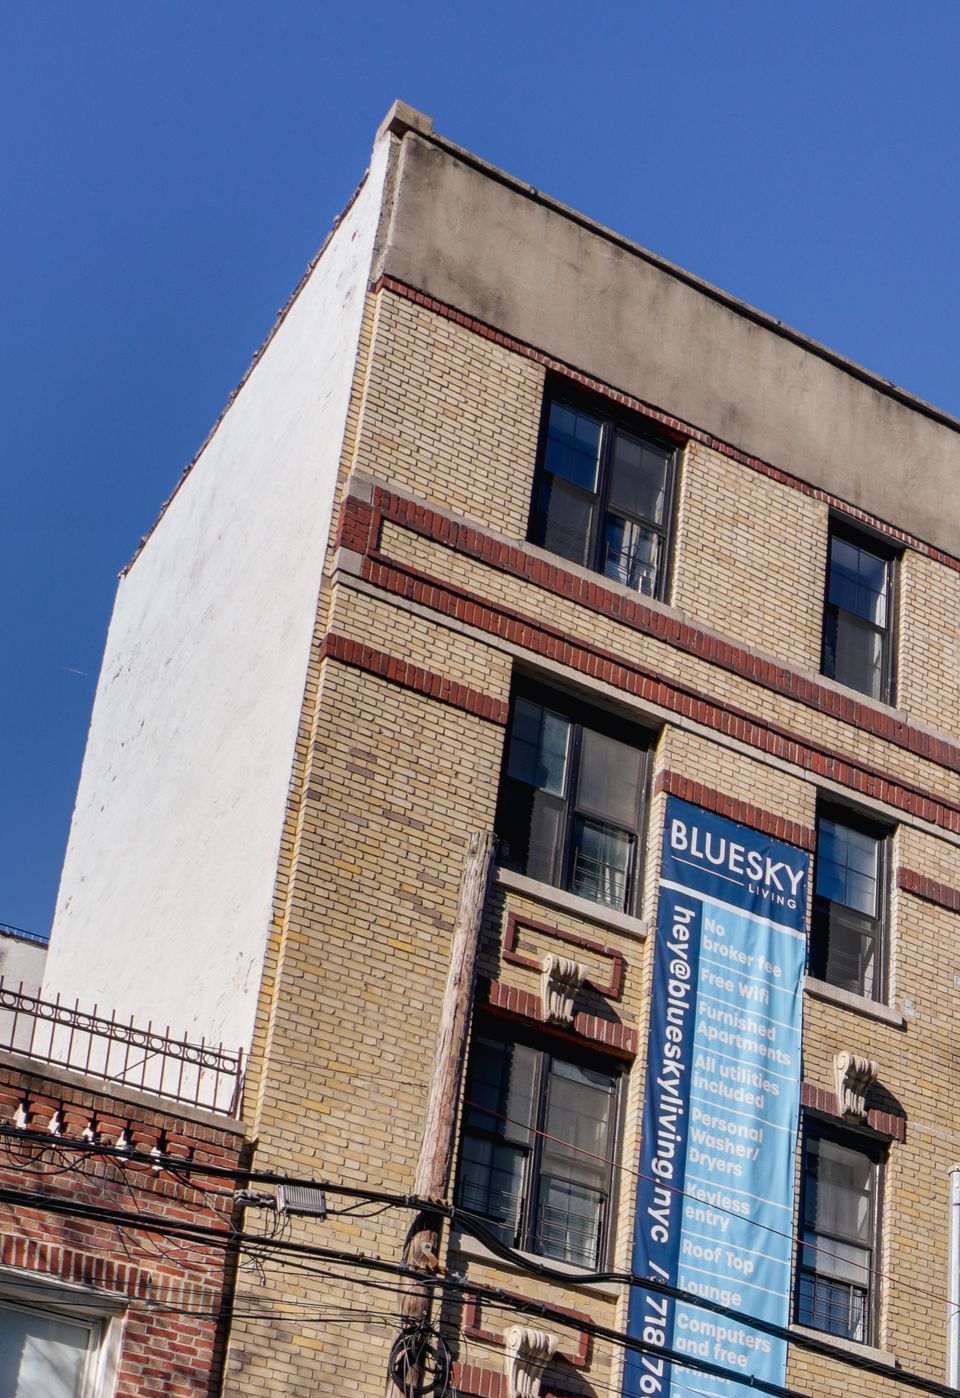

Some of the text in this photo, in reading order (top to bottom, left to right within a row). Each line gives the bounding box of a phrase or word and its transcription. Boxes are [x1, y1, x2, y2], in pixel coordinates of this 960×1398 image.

[671, 819, 804, 896] BLUESKY
[749, 883, 797, 909] LIVING
[704, 917, 726, 937] No
[703, 935, 782, 978] broker fee
[701, 968, 769, 1005] Free Wifi
[699, 1000, 776, 1042] Furnished
[697, 1020, 792, 1066] Apartments
[647, 905, 695, 1244] hey@blueskyliving.nyc
[693, 1073, 765, 1110] included
[695, 1053, 780, 1096] All utilities
[690, 1127, 760, 1161] Washer/
[691, 1107, 763, 1144] Personal
[689, 1147, 743, 1177] Dryers
[686, 1182, 750, 1215] Keyless
[685, 1206, 731, 1232] entry
[682, 1239, 754, 1275] Roof Top
[680, 1275, 742, 1307] Lounge
[677, 1312, 771, 1353] Computers
[675, 1336, 748, 1368] and free
